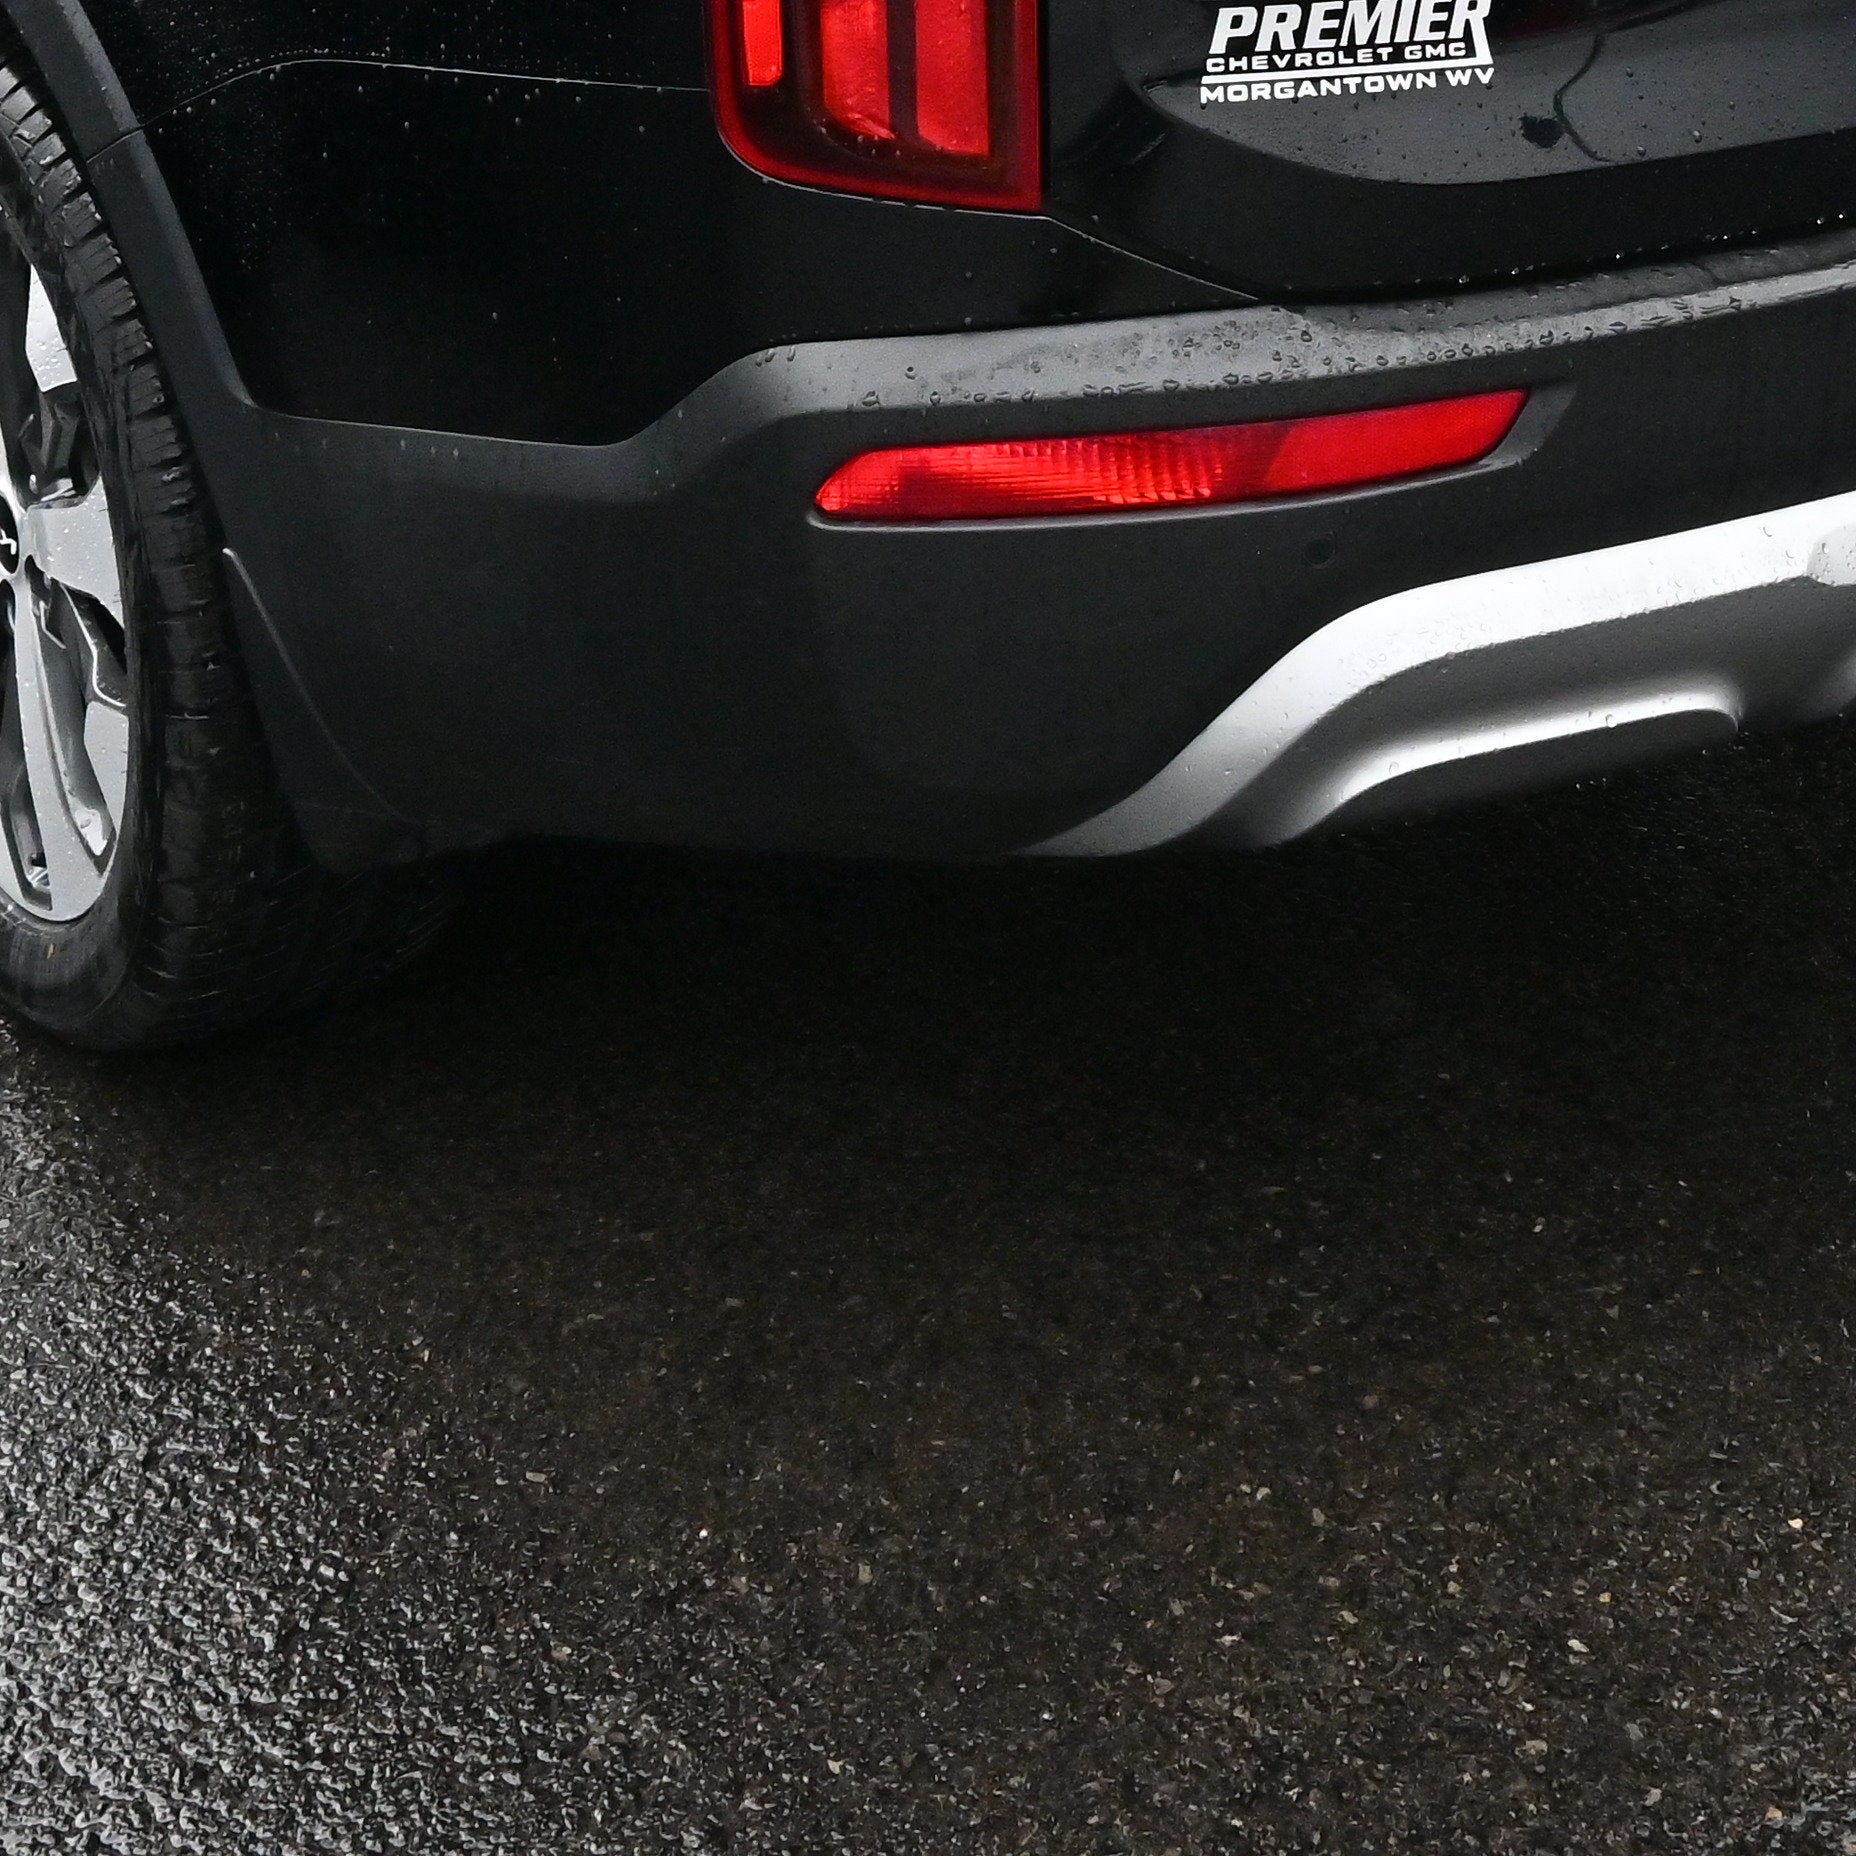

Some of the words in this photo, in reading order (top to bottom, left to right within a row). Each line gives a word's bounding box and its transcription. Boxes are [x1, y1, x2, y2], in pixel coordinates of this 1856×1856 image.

[1206, 46, 1393, 73] CHEVROLET
[1403, 42, 1467, 60] GMC
[1200, 70, 1437, 104] MORGANTOWN
[1445, 67, 1494, 87] WV
